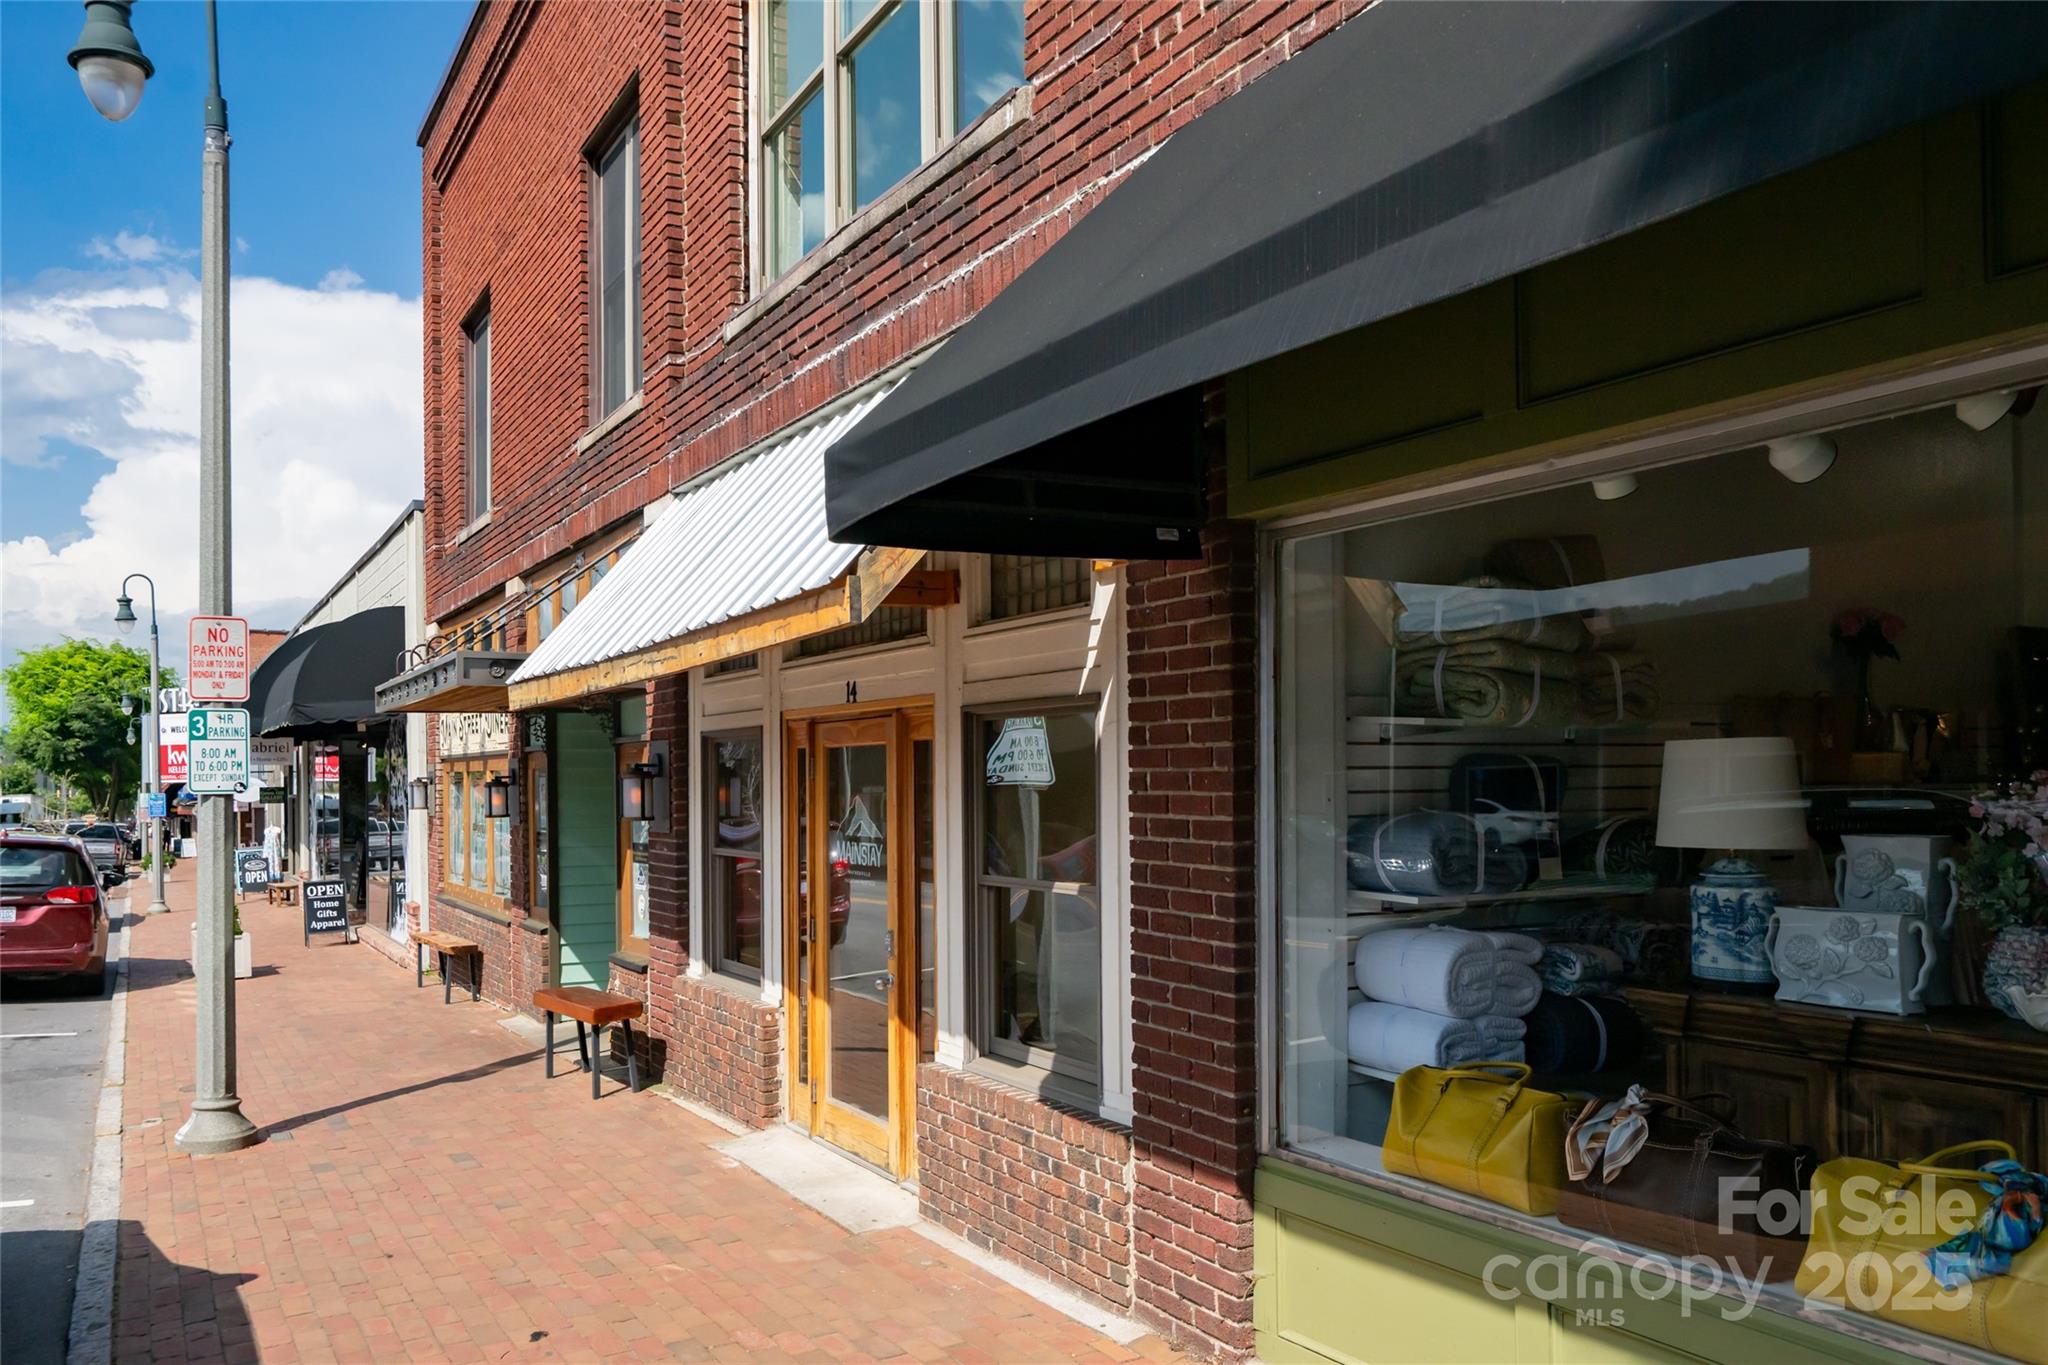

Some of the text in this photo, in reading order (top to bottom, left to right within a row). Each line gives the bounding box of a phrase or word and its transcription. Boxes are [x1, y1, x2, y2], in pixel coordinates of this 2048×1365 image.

[207, 627, 229, 643] NO
[193, 645, 244, 658] PARKING
[193, 671, 216, 679] MONDAY
[225, 671, 244, 679] FRIDAY
[211, 681, 225, 689] ONLY
[845, 680, 857, 703] 14
[191, 714, 234, 737] 3 HR
[208, 727, 245, 738] PARKING
[252, 742, 290, 753] abriel
[201, 748, 237, 759] 8:00 AM
[195, 761, 243, 771] TO 6:00 PM
[193, 774, 217, 782] EXCEPT
[221, 774, 245, 782] SUNDAY
[245, 870, 268, 884] OPEN
[306, 883, 344, 897] OPEN
[313, 900, 339, 909] Home
[316, 909, 338, 918] Gifts
[310, 918, 346, 930] Apparel
